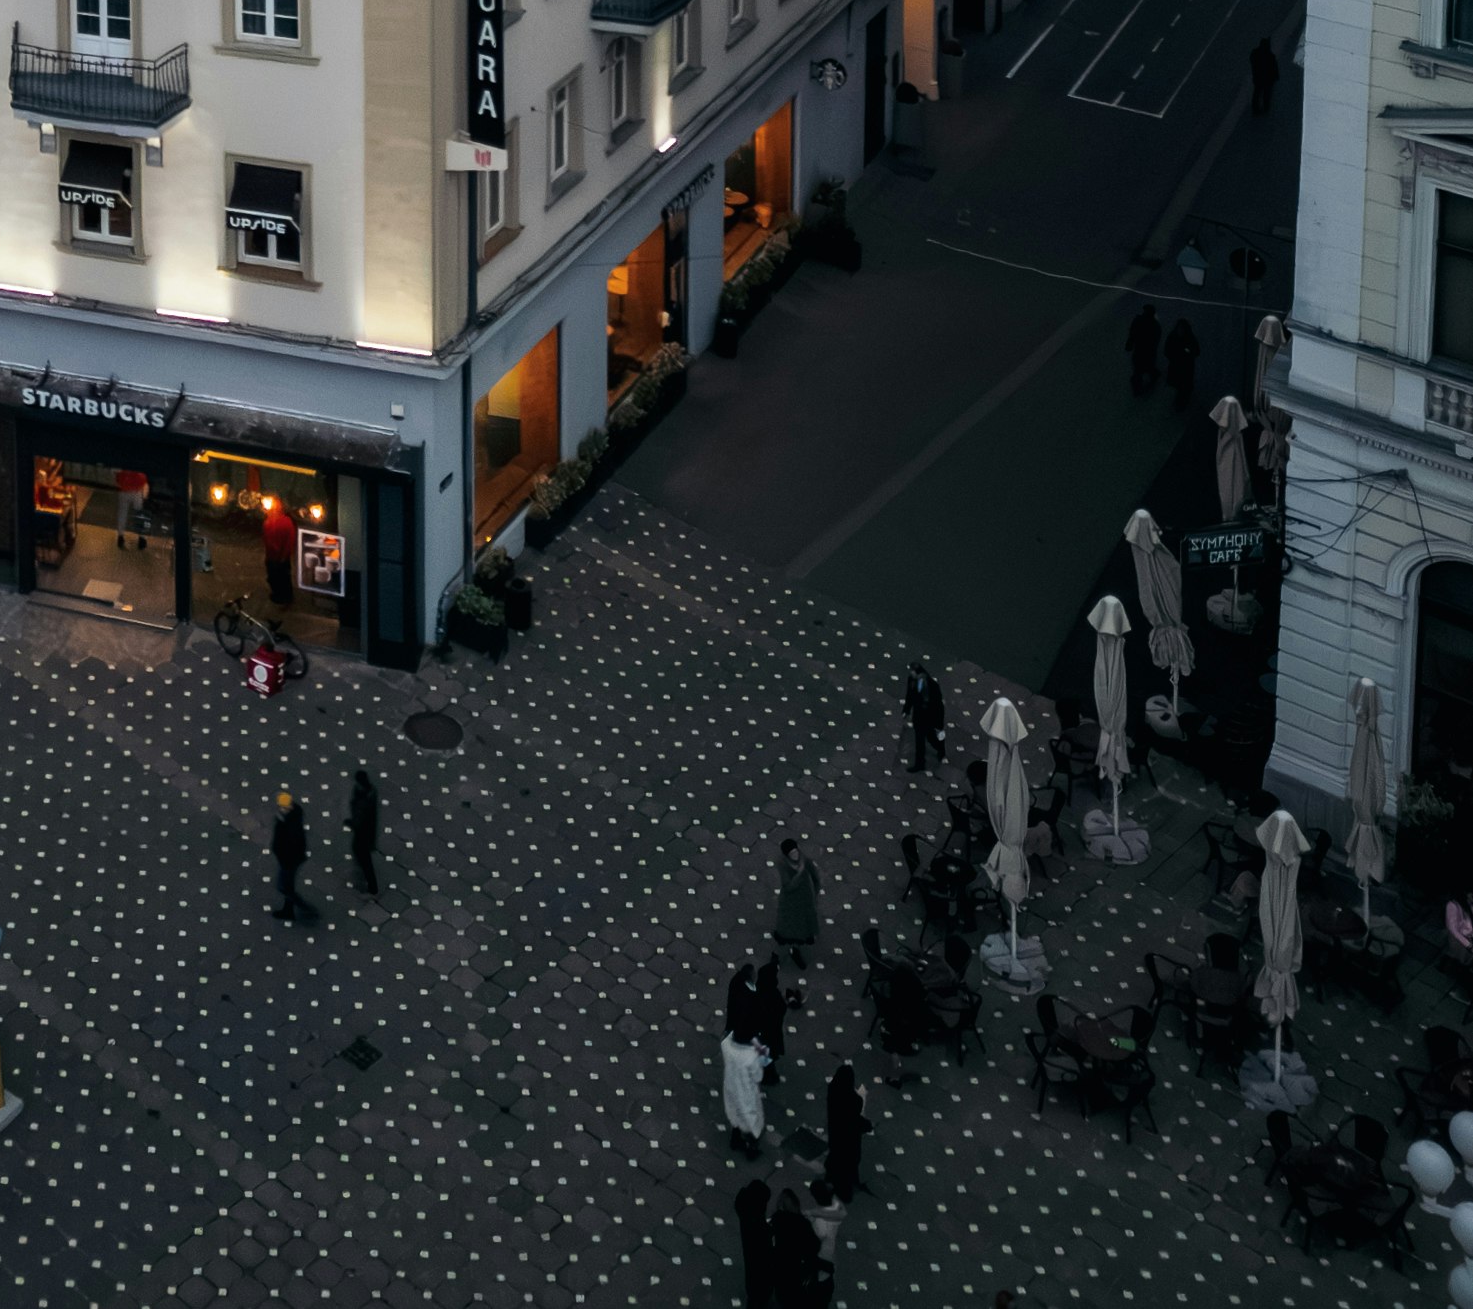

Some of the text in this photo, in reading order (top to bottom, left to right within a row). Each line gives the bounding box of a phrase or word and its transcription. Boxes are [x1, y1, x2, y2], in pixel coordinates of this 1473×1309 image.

[61, 190, 116, 209] UPSIDE
[229, 216, 288, 235] UPSIDE
[22, 387, 166, 429] STARBUCKS
